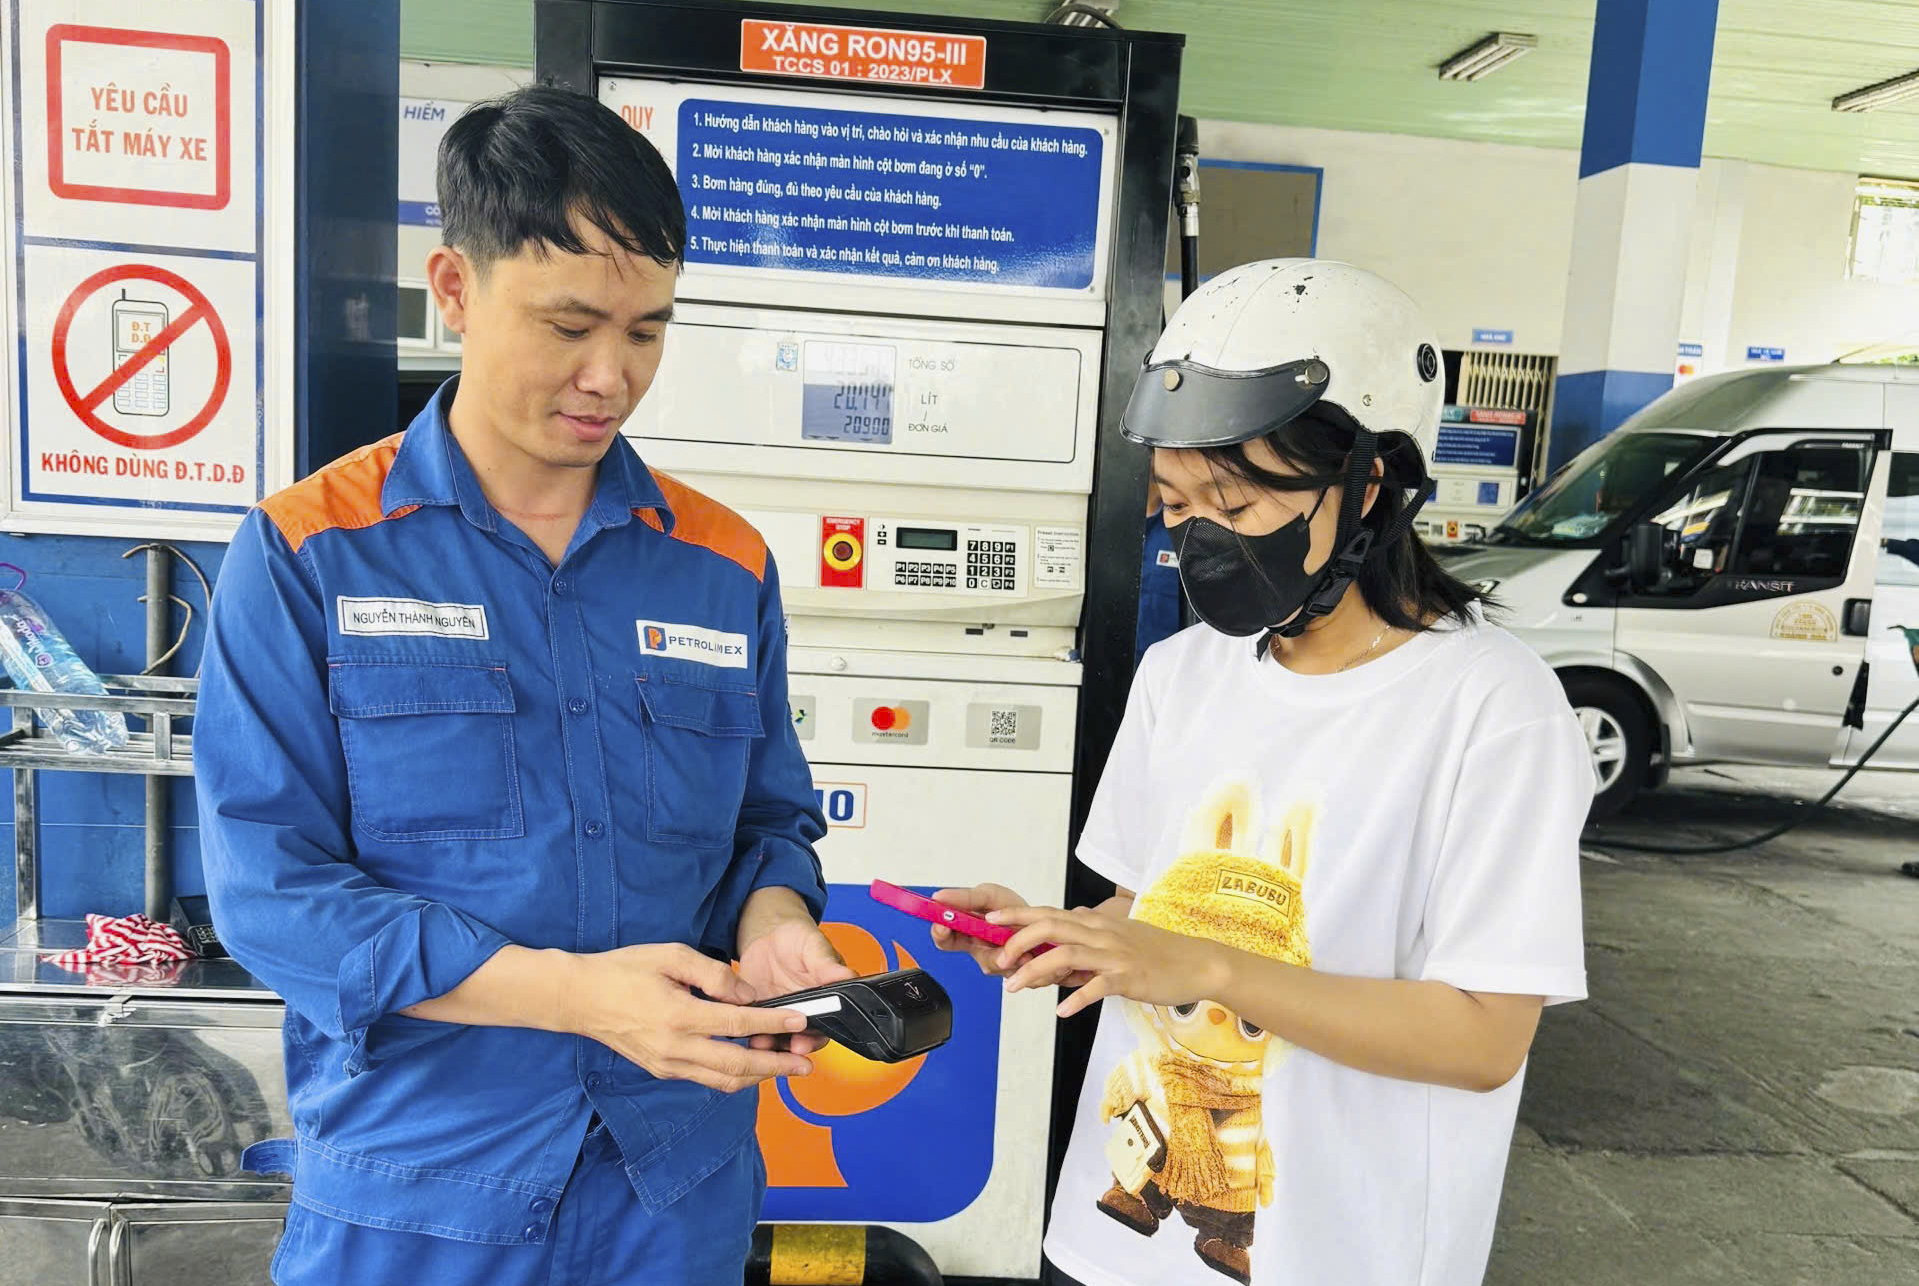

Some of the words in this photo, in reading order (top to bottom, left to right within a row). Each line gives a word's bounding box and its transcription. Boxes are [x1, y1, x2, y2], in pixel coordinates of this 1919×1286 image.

[761, 25, 839, 56] XĂNG
[848, 34, 967, 65] RON95-III
[773, 56, 825, 74] TCCS
[830, 60, 850, 76] 01
[868, 64, 952, 84] 2023/PLX
[90, 81, 136, 114] YÊU
[143, 82, 188, 118] CẦU
[72, 118, 114, 153] TẮT
[123, 127, 172, 158] MÁY
[180, 136, 208, 162] XE
[694, 112, 702, 126] 1.
[704, 113, 739, 132] Hướng
[742, 114, 760, 131] dẫn
[762, 117, 792, 134] khách
[794, 120, 818, 140] hàng
[821, 122, 838, 138] vào
[841, 124, 850, 140] vị
[852, 126, 865, 141] trí,
[868, 127, 891, 141] chào
[894, 127, 908, 142] hỏi
[912, 129, 922, 144] và
[924, 130, 942, 145] xác
[944, 131, 968, 150] nhận
[970, 133, 989, 148] nhu
[991, 132, 1008, 150] cầu
[1011, 136, 1028, 151] của
[1030, 138, 1059, 154] khách
[1062, 140, 1088, 158] hàng.
[693, 144, 701, 158] 2.
[704, 144, 722, 159] Mời
[725, 145, 754, 162] khách
[757, 148, 781, 168] hàng
[784, 151, 801, 166] xác
[803, 152, 827, 171] nhận
[830, 154, 850, 169] màn
[853, 156, 874, 171] hình
[876, 158, 892, 174] cột
[894, 160, 916, 174] bơm
[919, 161, 942, 179] đang
[945, 162, 952, 177] ở
[954, 160, 966, 177] số
[692, 174, 700, 189] 3.
[703, 176, 726, 191] Bơm
[730, 178, 754, 196] hàng
[756, 180, 784, 198] đúng,
[786, 182, 798, 196] đủ
[801, 183, 822, 198] theo
[824, 184, 842, 202] yêu
[844, 183, 862, 200] cầu
[864, 187, 882, 202] của
[884, 189, 912, 205] khách
[915, 191, 942, 210] hàng.
[690, 205, 700, 220] 4.
[702, 206, 721, 221] Mời
[723, 207, 752, 224] khách
[755, 210, 780, 228] hàng
[781, 212, 798, 227] xác
[801, 214, 825, 232] nhận
[827, 216, 848, 230] màn
[850, 216, 872, 232] hình
[874, 219, 890, 236] cột
[892, 221, 913, 236] bơm
[916, 222, 942, 238] trước
[945, 224, 960, 239] khi
[962, 226, 988, 240] thanh
[991, 226, 1014, 242] toán.
[690, 236, 699, 250] 5.
[702, 236, 727, 254] Thực
[730, 238, 750, 256] hiện
[752, 242, 780, 256] thanh
[782, 243, 804, 258] toán
[806, 244, 818, 258] và
[820, 246, 836, 260] xác
[839, 246, 863, 265] nhận
[865, 246, 880, 263] kết
[882, 250, 902, 267] quả,
[904, 252, 925, 266] cảm
[927, 254, 940, 268] ơn
[942, 254, 971, 269] khách
[974, 256, 1000, 274] hàng.
[921, 391, 938, 405] LÍT
[844, 416, 890, 436] 20900
[930, 422, 948, 434] GIÁ
[41, 449, 108, 476] KHÔNG
[116, 453, 168, 479] DÙNG
[174, 461, 245, 484] Đ.T.D.Đ
[969, 554, 976, 562] 4
[982, 554, 988, 564] 5
[994, 555, 1000, 564] 6
[970, 541, 976, 550] 7
[982, 542, 988, 551] 8
[994, 542, 1001, 552] 9
[909, 564, 918, 572] P2
[922, 564, 930, 572] P3
[946, 566, 956, 574] P5
[909, 576, 918, 584] P7
[982, 566, 988, 576] 2
[994, 568, 1000, 576] 3
[968, 579, 975, 588] 0
[981, 580, 988, 588] C
[668, 636, 742, 655] PETROLIMEX
[1222, 876, 1287, 906] ZABUBU
